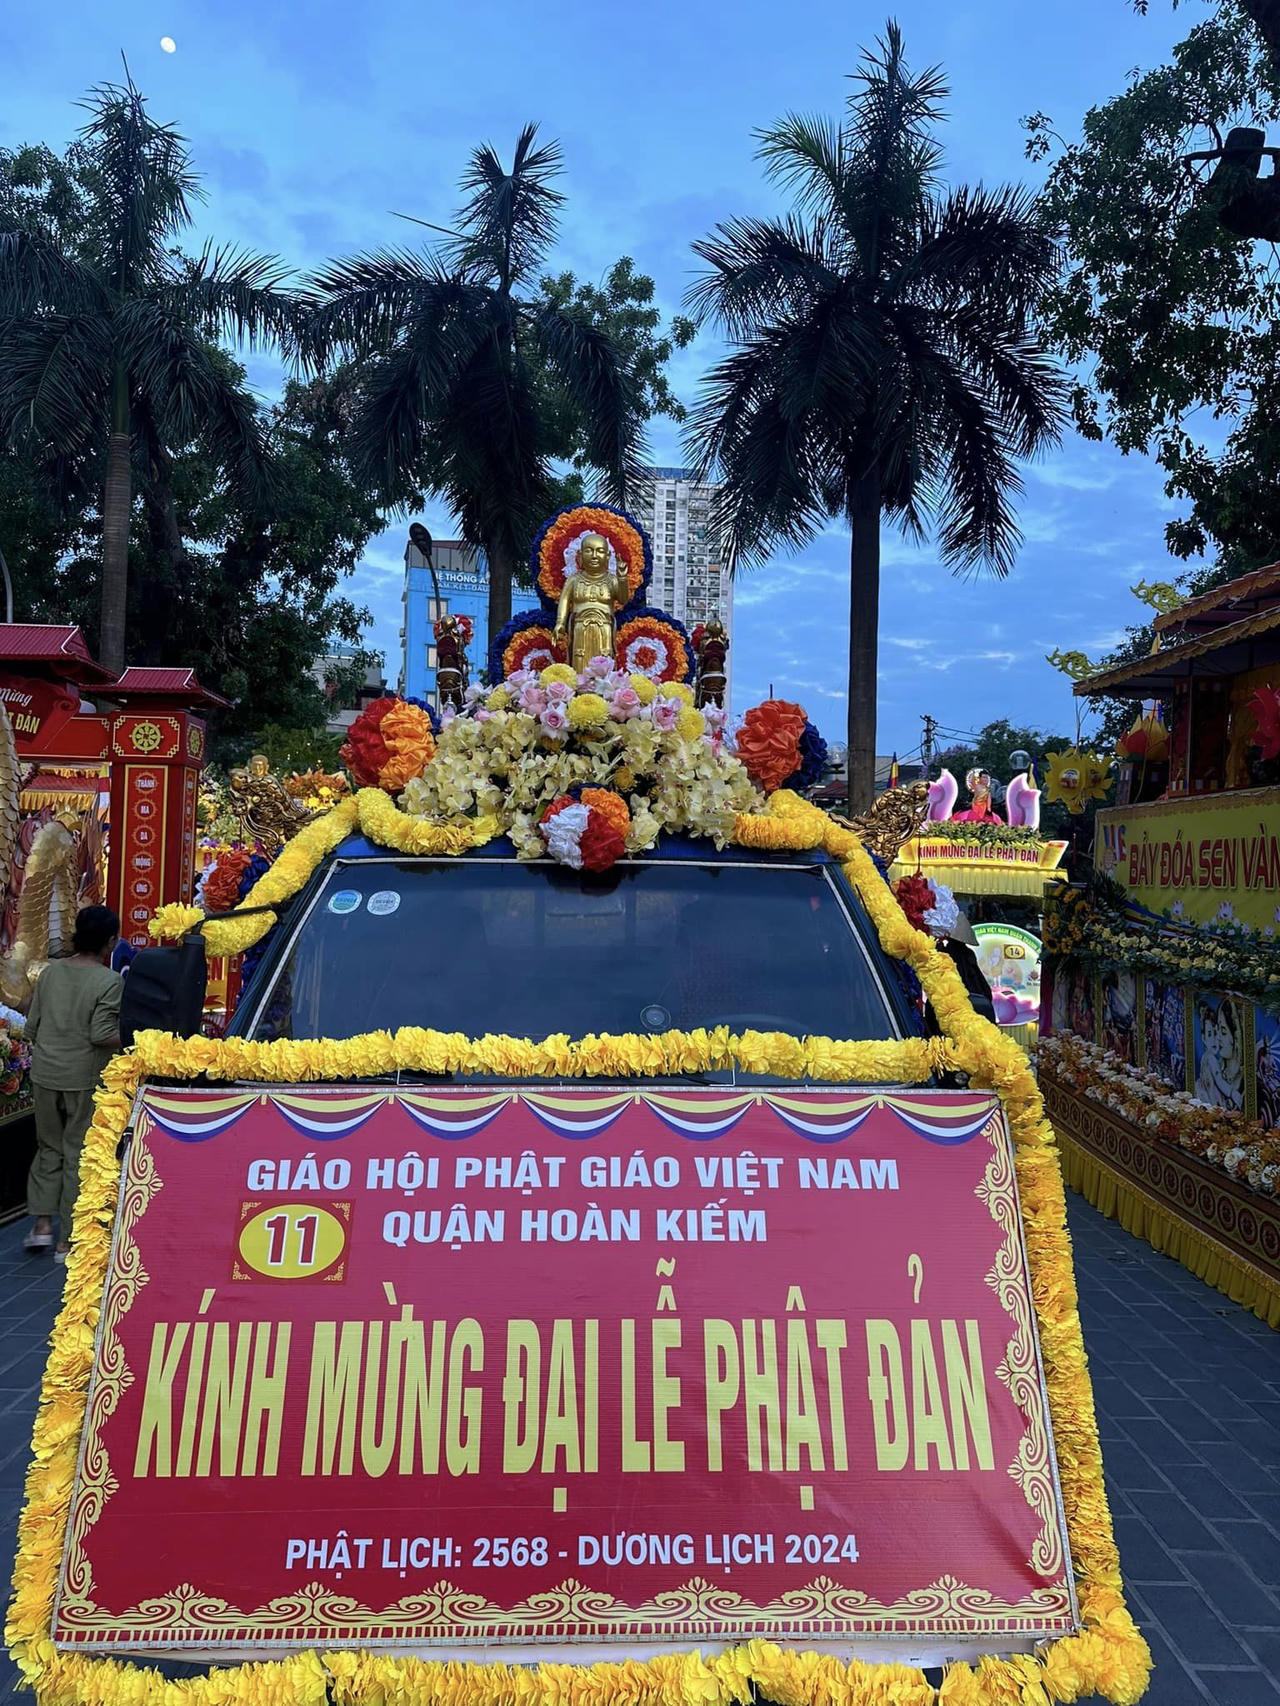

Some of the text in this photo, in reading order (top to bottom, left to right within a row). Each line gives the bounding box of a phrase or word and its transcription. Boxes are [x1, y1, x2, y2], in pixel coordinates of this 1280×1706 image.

[446, 572, 477, 584] THỐNG
[15, 710, 40, 734] ĐẢN
[1129, 830, 1159, 886] BẢY
[1160, 829, 1195, 887] ĐÓA
[1199, 838, 1237, 888] SEN
[1009, 947, 1020, 956] 14
[247, 1150, 900, 1197] GIÁO HỘI PHẬT GIÁO VIỆT NAM
[265, 1213, 320, 1266] 11
[382, 1198, 768, 1250] QUẬN HOÀN KIẾM
[133, 1253, 996, 1513] KÍNH MỪNG ĐẠI LỄ PHẬT ĐẢN
[285, 1530, 373, 1579] PHẬT
[382, 1537, 462, 1579] LỊCH:
[473, 1537, 549, 1567] 2568
[577, 1531, 694, 1566] DƯƠNG
[705, 1534, 774, 1573] LỊCH
[784, 1533, 860, 1564] 2024
